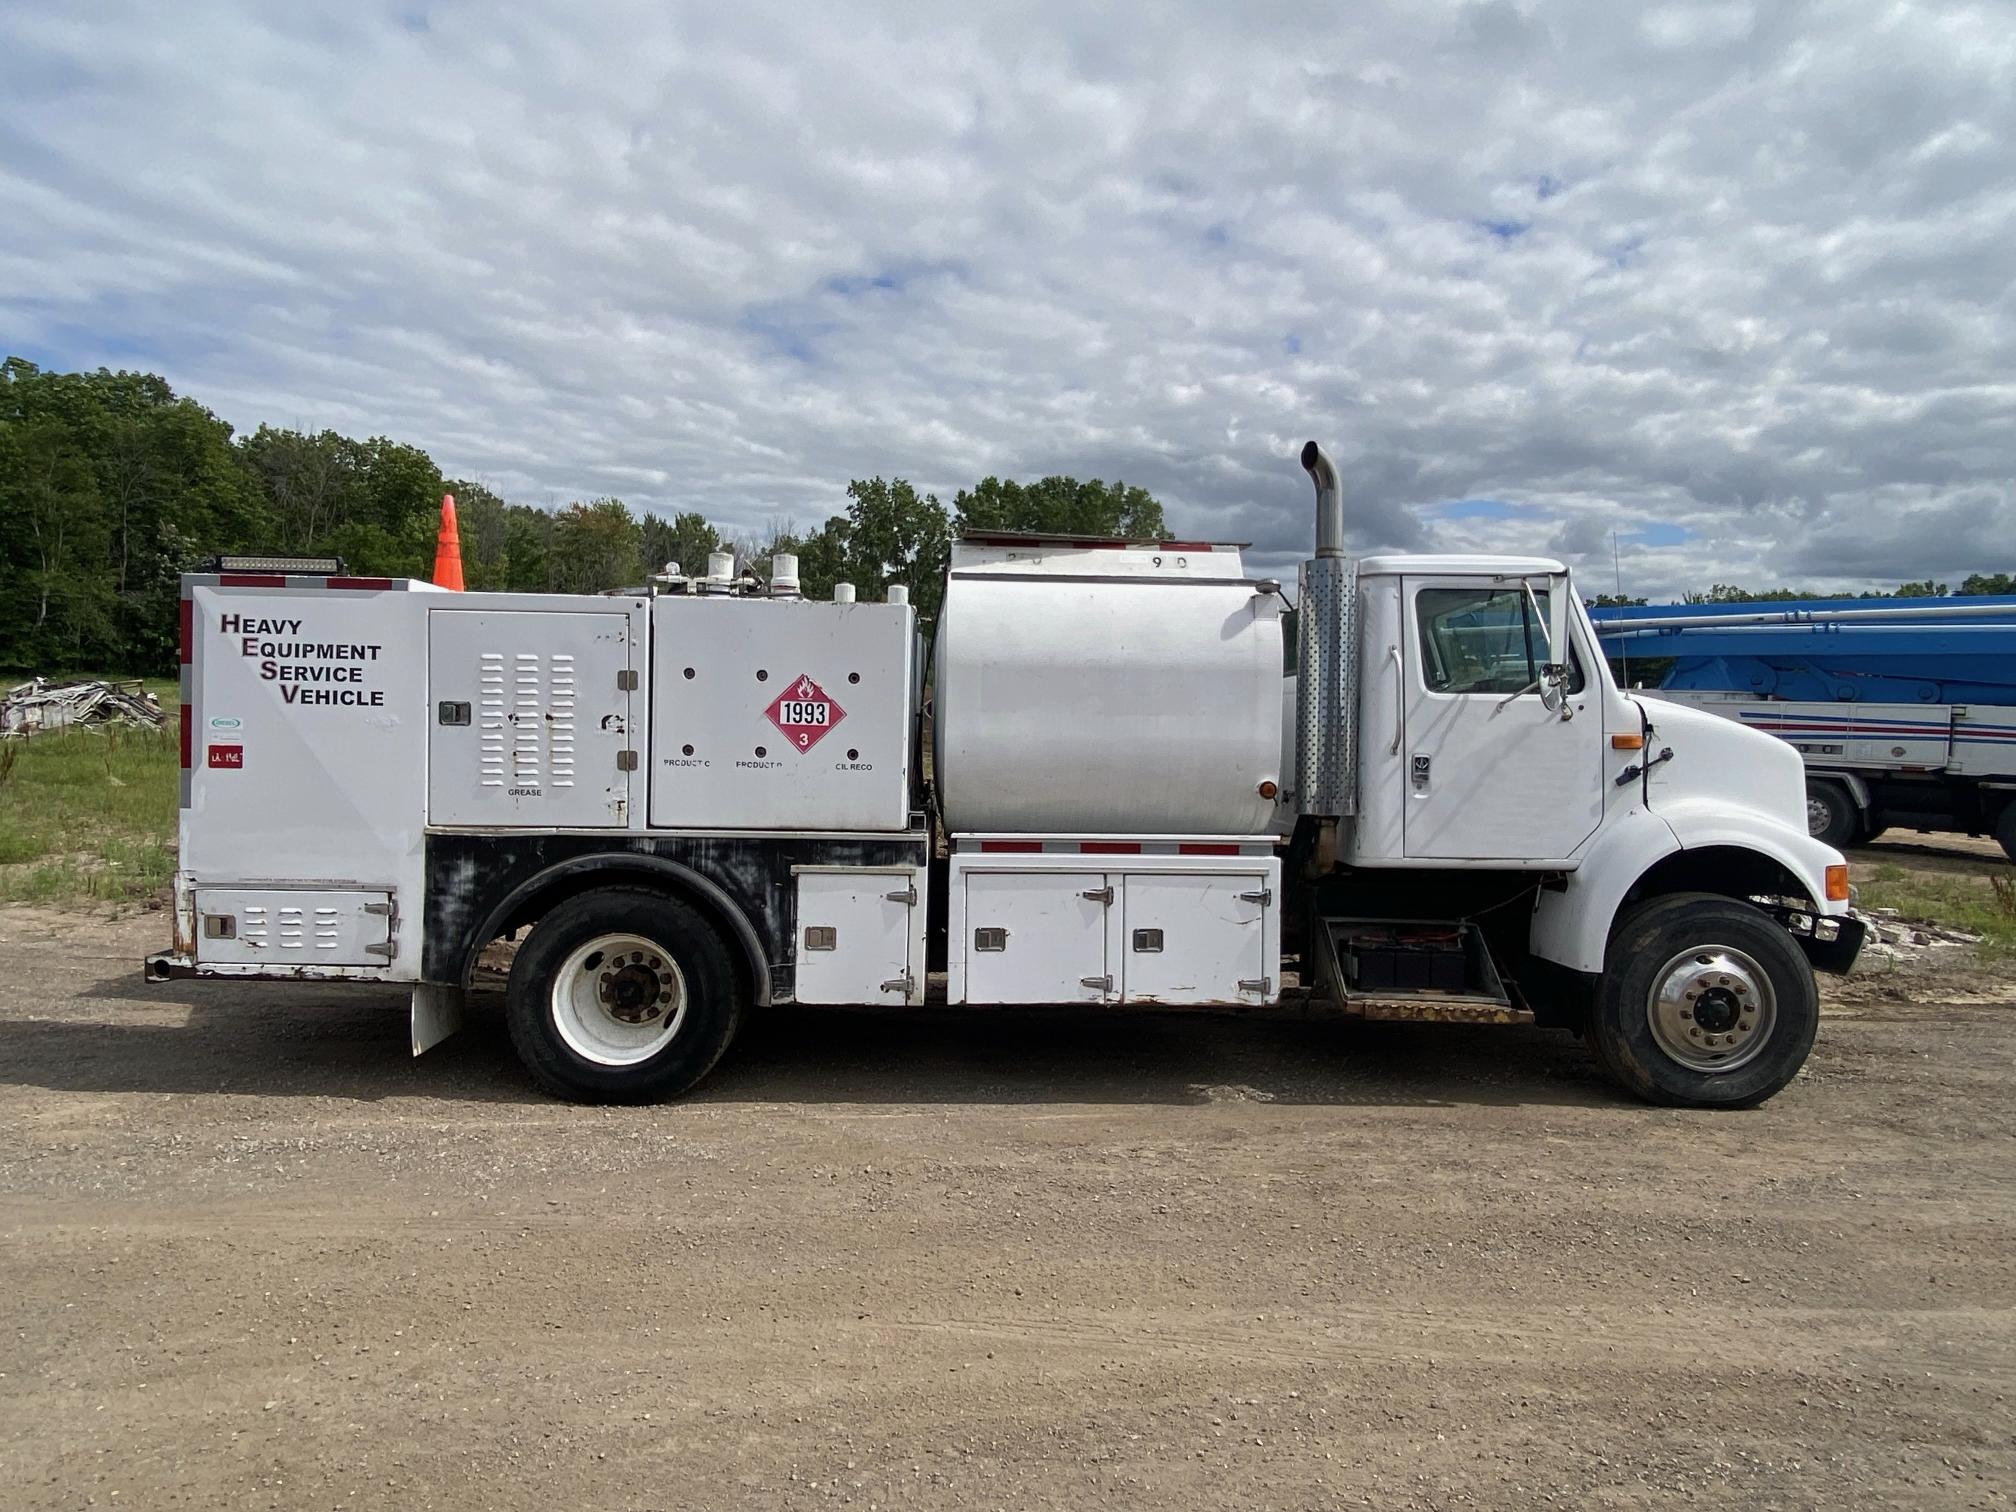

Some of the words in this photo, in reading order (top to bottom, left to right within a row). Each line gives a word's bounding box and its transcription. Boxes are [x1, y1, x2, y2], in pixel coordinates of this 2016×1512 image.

[220, 613, 302, 635] HEAVY
[242, 637, 382, 661] EQUIPMENT
[260, 661, 363, 683] SERVICE
[279, 684, 384, 706] VEHICLE
[784, 702, 825, 724] 1993
[799, 733, 809, 746] 3
